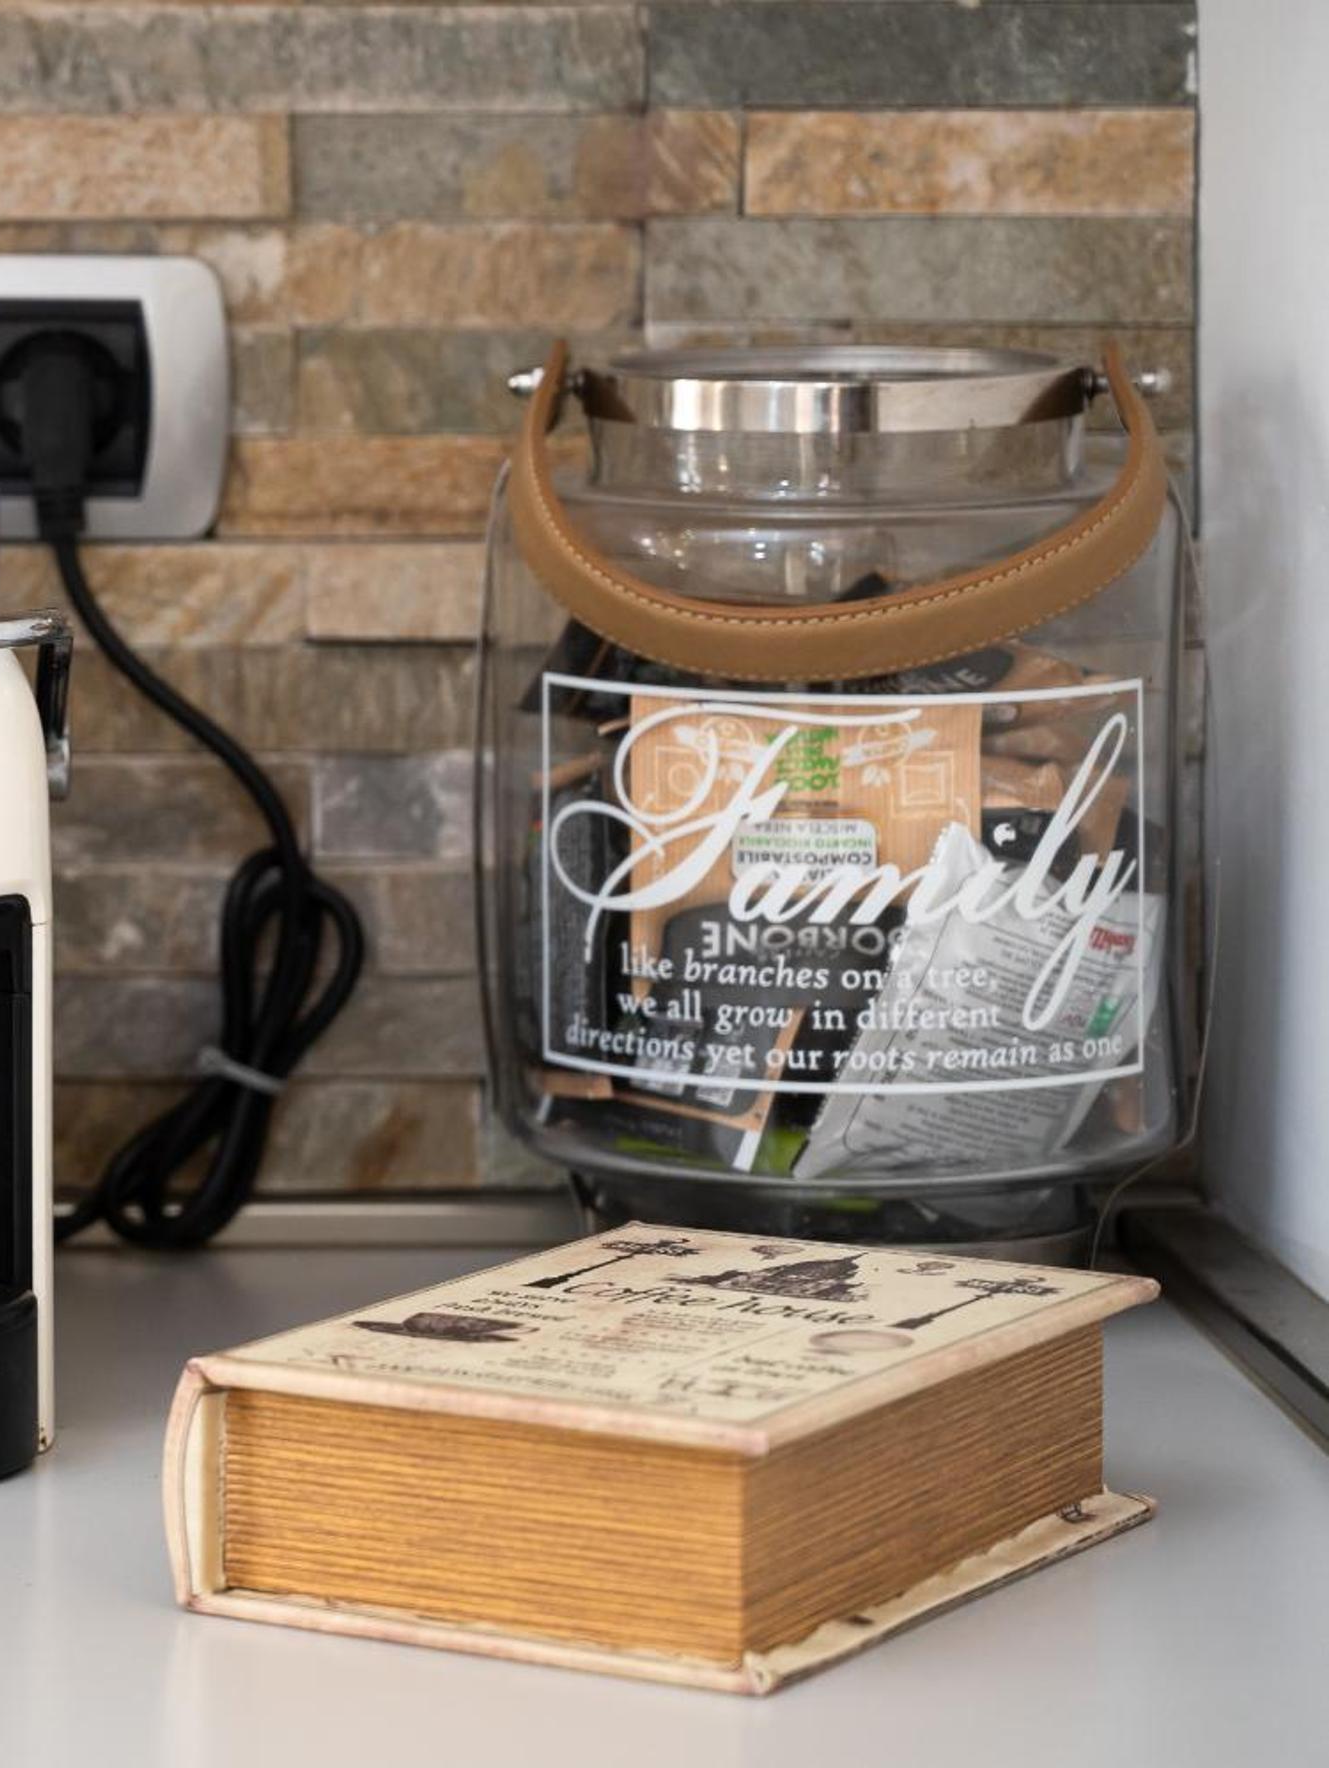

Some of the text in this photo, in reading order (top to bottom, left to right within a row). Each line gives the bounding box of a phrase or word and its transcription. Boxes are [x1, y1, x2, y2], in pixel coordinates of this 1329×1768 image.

[551, 702, 1136, 1030] Family
[736, 850, 873, 866] COMPOSTABILE
[619, 940, 673, 979] like
[683, 948, 830, 990] branches
[841, 967, 884, 990] on
[896, 970, 914, 988] a
[616, 989, 1000, 1034] we all grow in different
[565, 1012, 695, 1063] directions
[705, 1040, 756, 1075] yet
[765, 1048, 824, 1071] our
[833, 1048, 915, 1071] roots
[926, 1036, 1038, 1070] remain
[1048, 1042, 1074, 1063] as
[562, 1280, 716, 1305] Coffee
[718, 1296, 875, 1324] house
